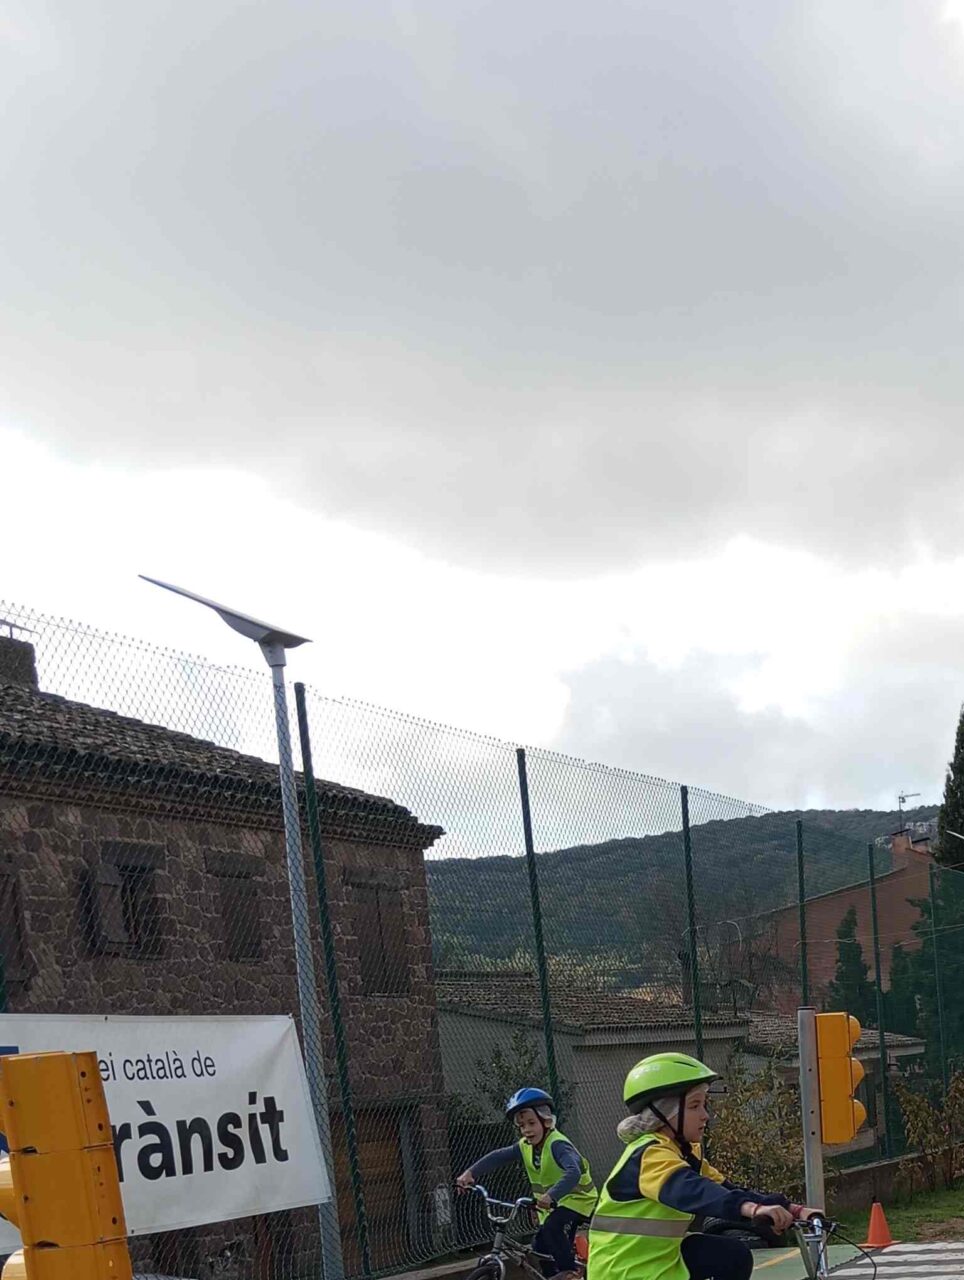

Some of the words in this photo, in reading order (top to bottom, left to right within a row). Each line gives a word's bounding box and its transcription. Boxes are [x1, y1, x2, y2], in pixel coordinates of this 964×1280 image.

[98, 1052, 117, 1081] ei
[123, 1050, 186, 1081] català
[191, 1051, 217, 1078] de
[111, 1091, 289, 1183] rànsit
